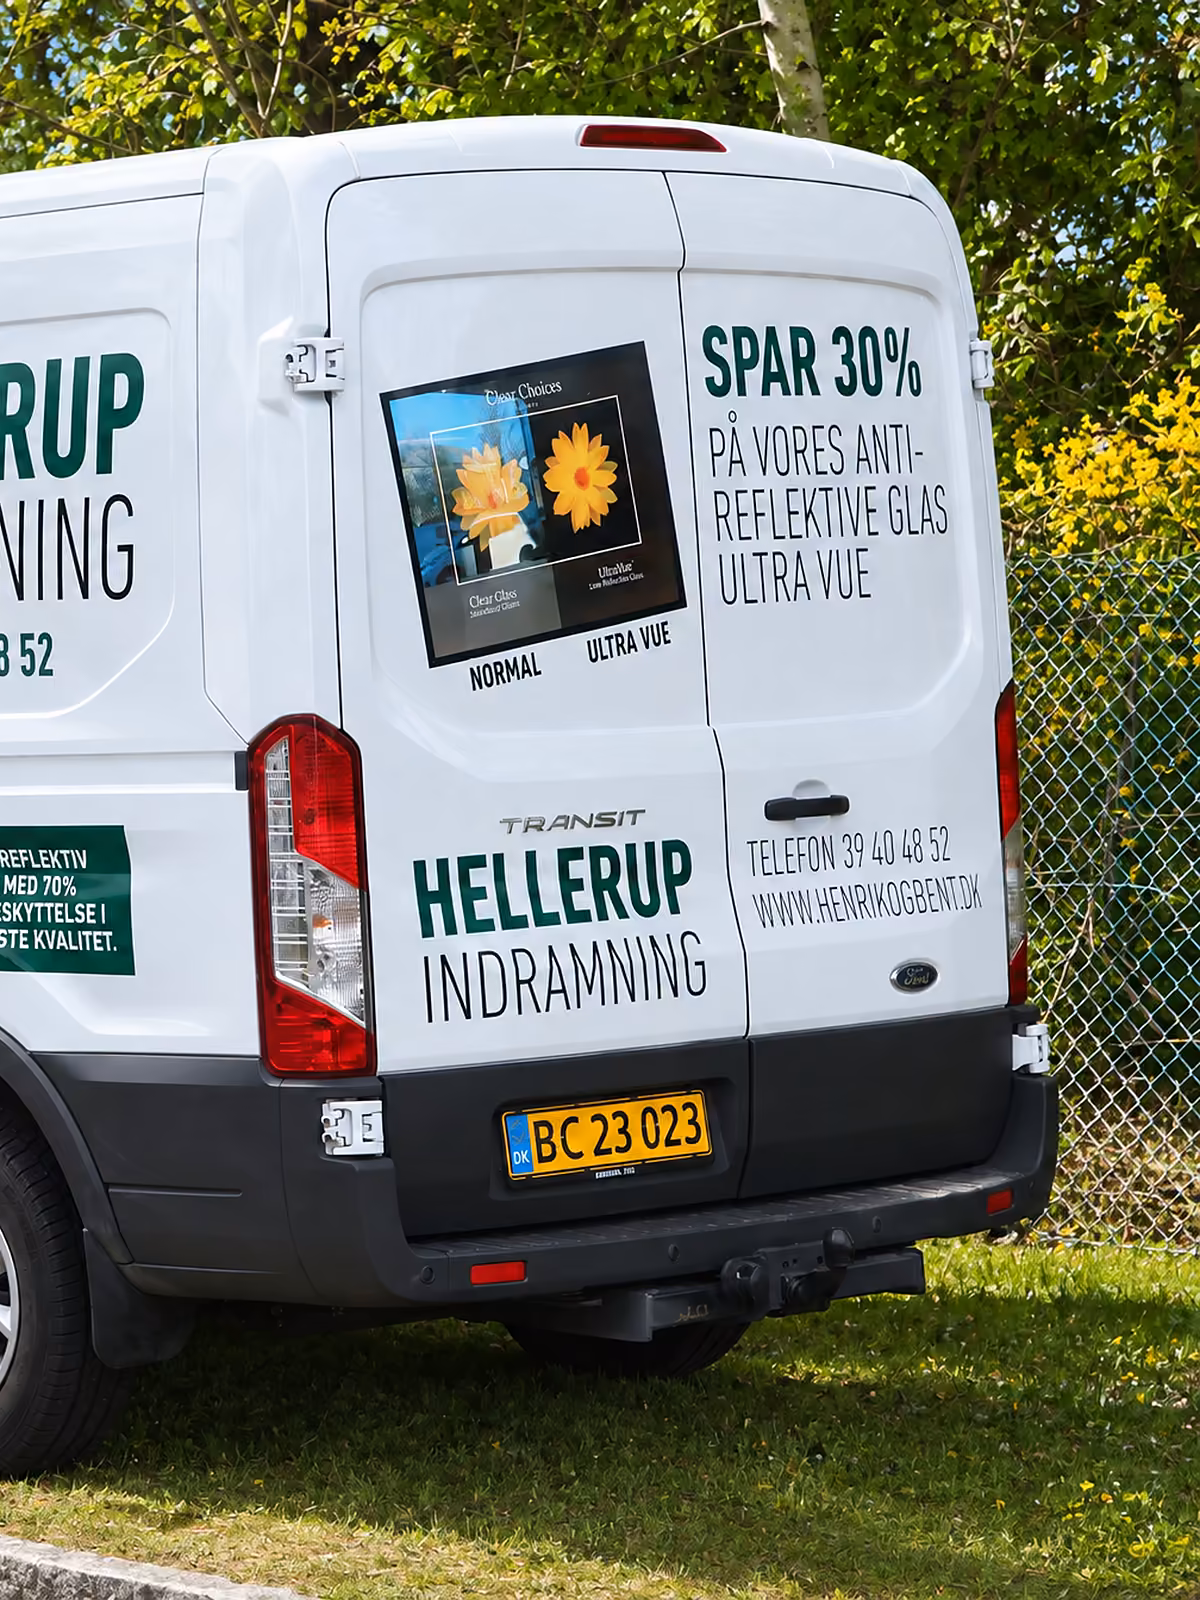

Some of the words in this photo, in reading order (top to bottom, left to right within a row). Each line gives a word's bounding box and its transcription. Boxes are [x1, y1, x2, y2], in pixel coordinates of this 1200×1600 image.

[702, 324, 822, 398] SPAR
[831, 325, 923, 397] 30%
[518, 381, 562, 400] Choices
[709, 410, 747, 478] PÅ
[752, 424, 845, 477] VORES
[856, 424, 923, 475] ANTI-
[713, 485, 879, 542] REFLEKTIVE
[888, 484, 948, 536] GLAS
[719, 550, 812, 605] ULTRA
[816, 548, 872, 600] VUE
[20, 632, 54, 677] 52
[586, 628, 637, 664] ULTRA
[639, 620, 672, 650] VUE
[469, 652, 542, 692] NORMAL
[499, 808, 646, 834] TRANSIT
[746, 835, 835, 877] TELEFON
[841, 832, 864, 869] 39
[871, 829, 895, 866] 40
[902, 827, 924, 864] 48
[929, 825, 951, 862] 52
[3, 875, 38, 896] MED
[42, 875, 77, 897] 70%
[413, 838, 693, 939] HELLERUP
[751, 873, 983, 929] WWW.HENRIKOGBENT.DK
[101, 903, 106, 924] I
[33, 928, 118, 952] KVALITET.
[423, 930, 707, 1024] INDRAMNING
[533, 1115, 584, 1164] BC
[590, 1110, 632, 1157] 23
[640, 1101, 702, 1150] 023
[513, 1150, 530, 1164] DK
